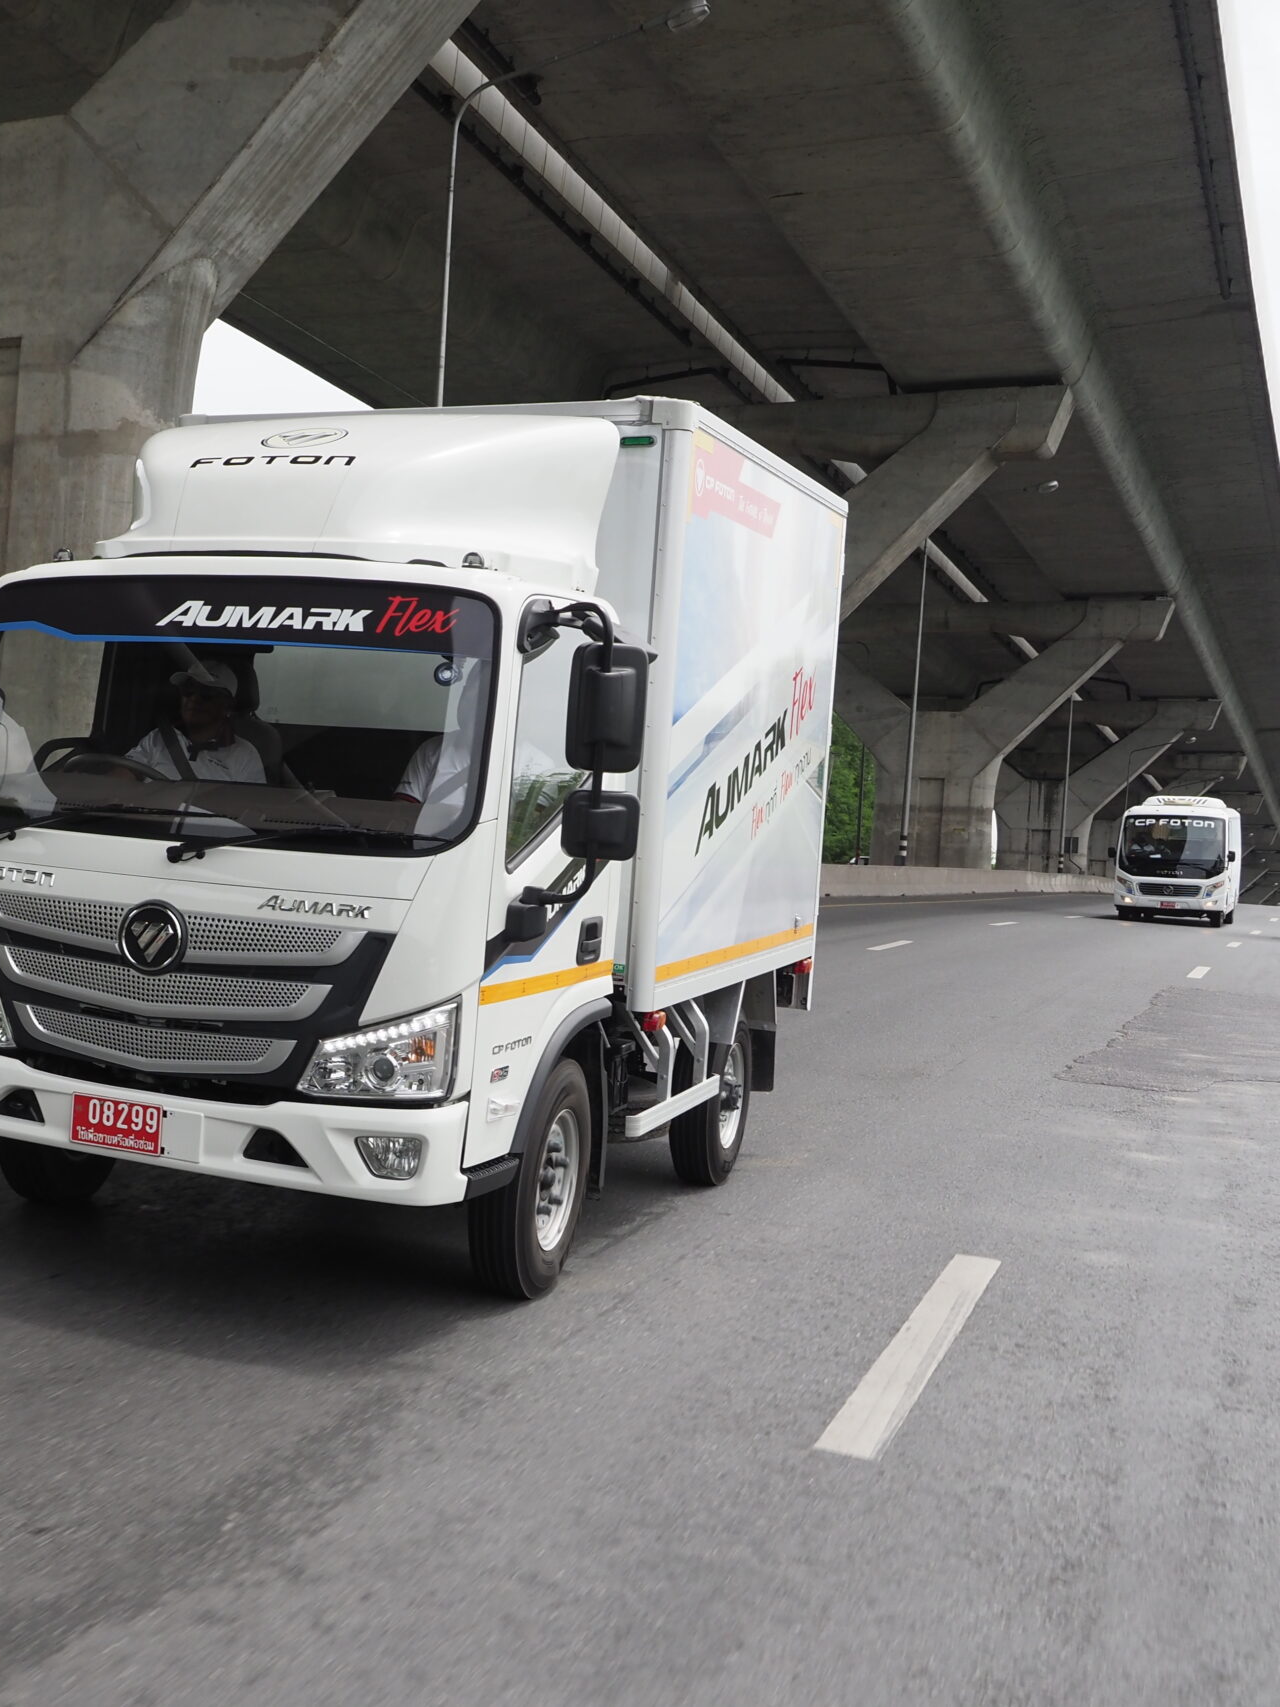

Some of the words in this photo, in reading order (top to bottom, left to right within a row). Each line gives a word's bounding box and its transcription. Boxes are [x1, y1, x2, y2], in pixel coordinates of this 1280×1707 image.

[190, 455, 356, 468] FOTON
[155, 600, 373, 632] AUMARK
[375, 595, 461, 637] Flex
[694, 707, 788, 857] AUMARK
[789, 665, 817, 741] Flex
[1134, 818, 1156, 826] CP
[1158, 818, 1215, 829] FOTON
[257, 894, 373, 919] AUMARK
[504, 1035, 532, 1052] FOTON
[88, 1098, 158, 1133] 08299
